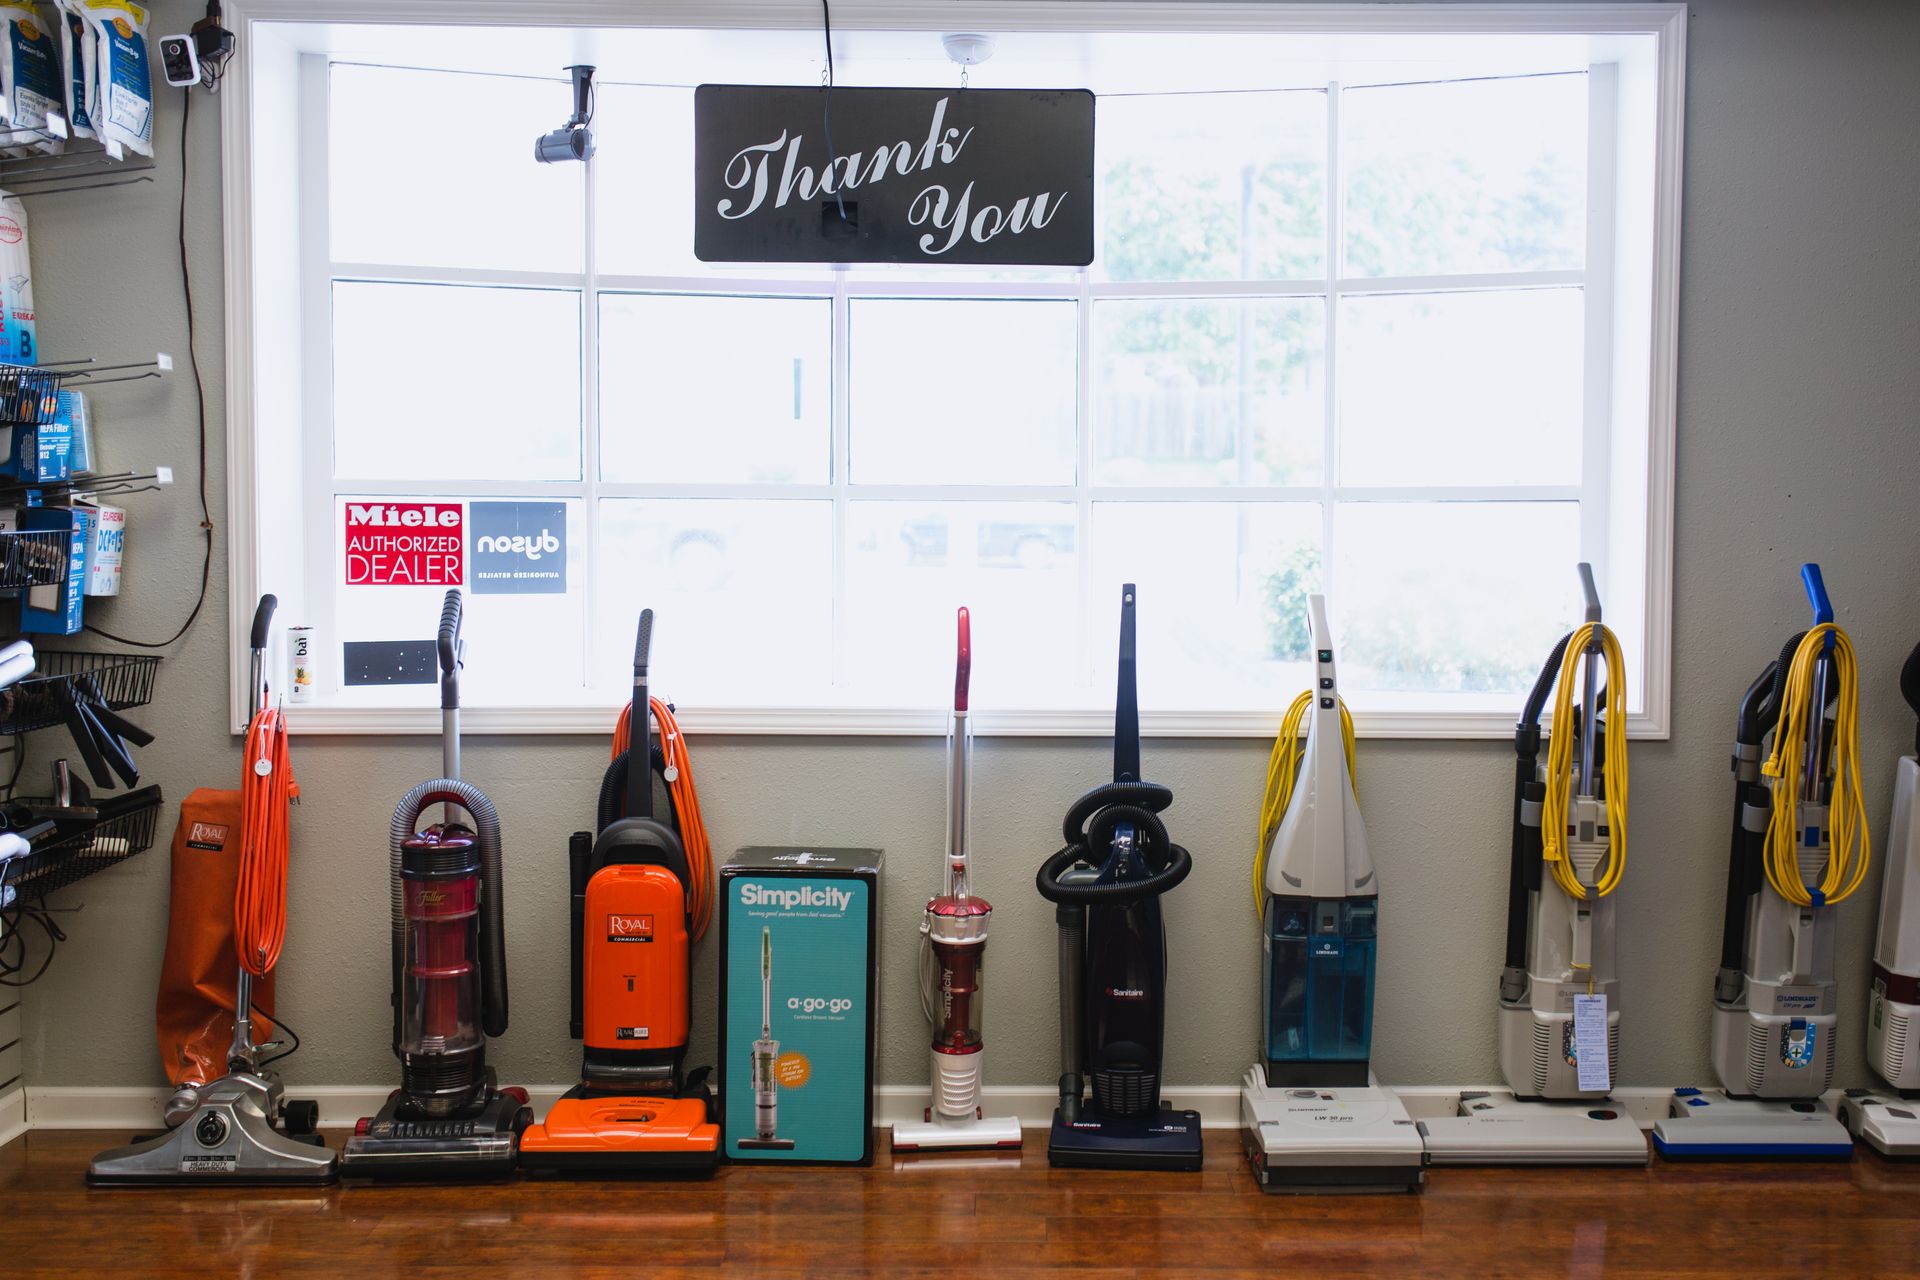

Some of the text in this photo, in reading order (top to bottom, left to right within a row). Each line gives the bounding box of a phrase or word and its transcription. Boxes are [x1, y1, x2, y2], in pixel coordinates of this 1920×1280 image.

[717, 97, 975, 220] Thank
[908, 180, 1068, 255] You
[20, 330, 33, 358] B
[348, 505, 460, 527] Miele
[348, 536, 460, 553] AUTHORIZED
[347, 555, 460, 583] DEALER
[294, 637, 307, 656] bai
[740, 883, 852, 912] Simplicity
[611, 916, 650, 934] ROYAL
[944, 968, 954, 1018] Simplicity
[1113, 988, 1144, 997] Sanitaire
